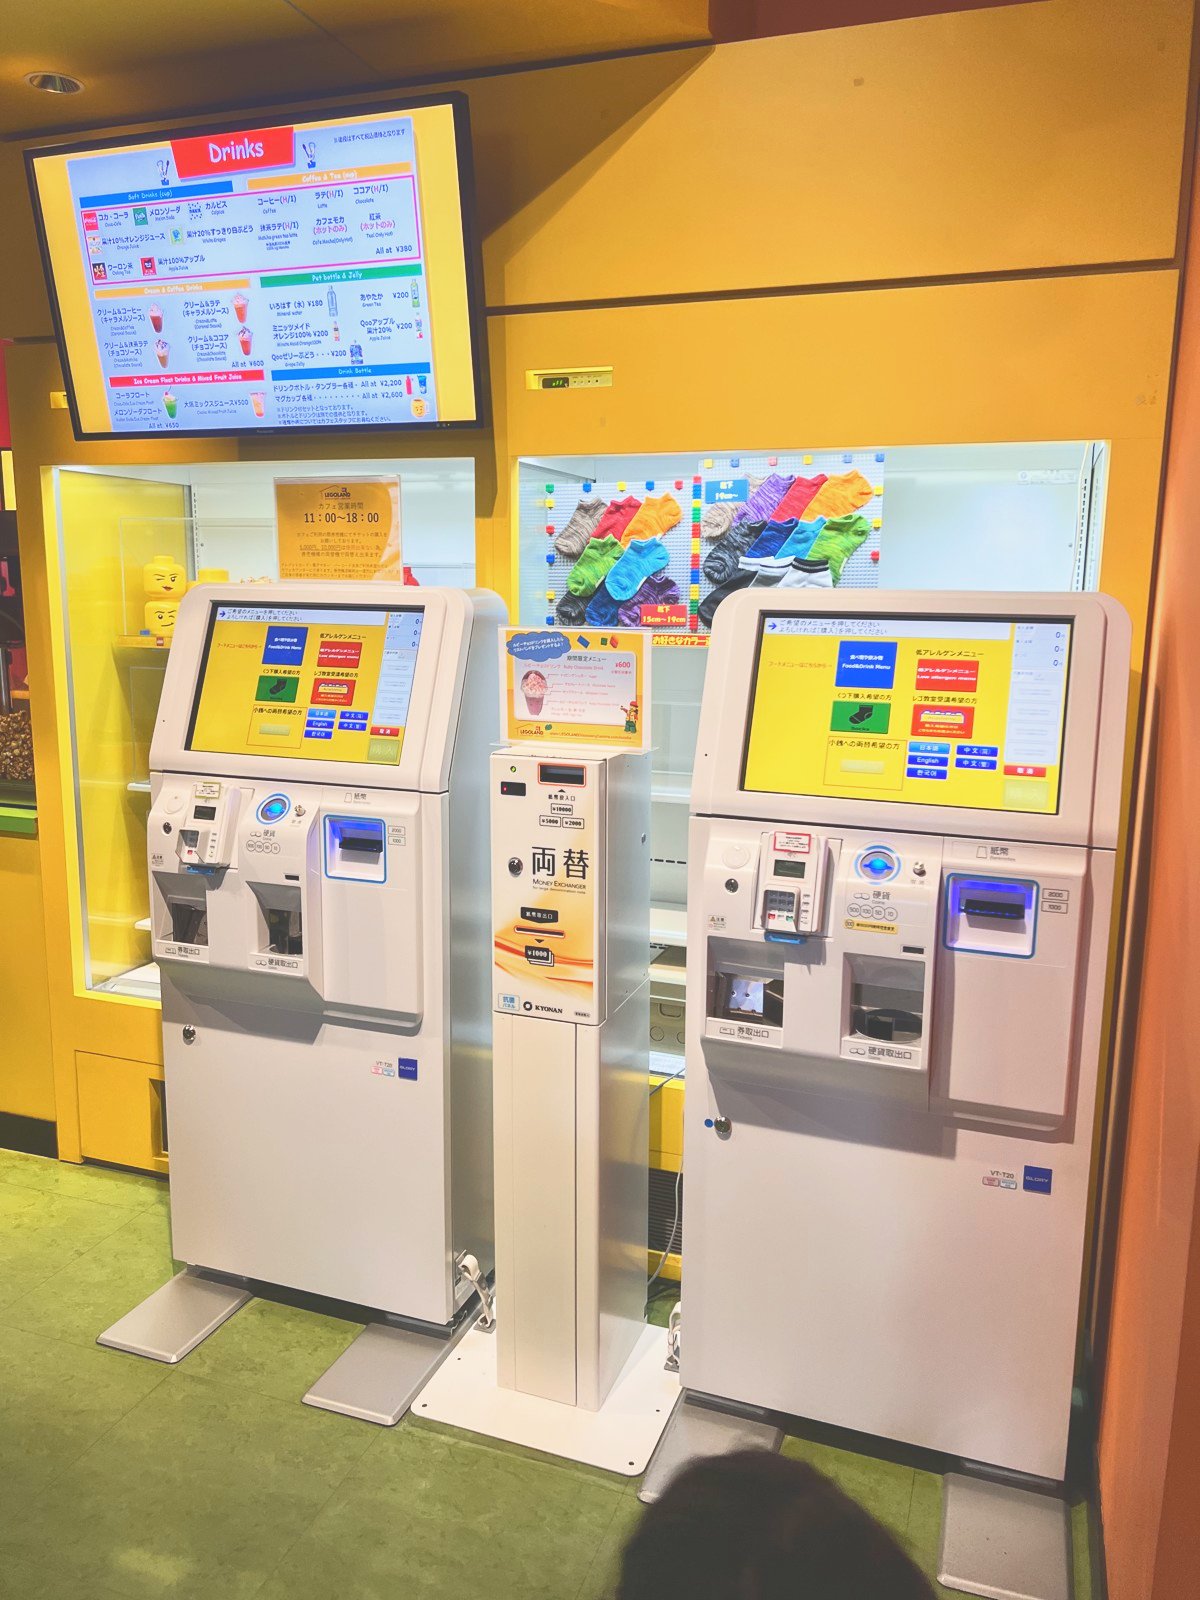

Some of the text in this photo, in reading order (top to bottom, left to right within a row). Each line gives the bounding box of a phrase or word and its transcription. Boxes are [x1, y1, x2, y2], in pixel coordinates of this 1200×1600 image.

[208, 138, 264, 163] Drinks
[141, 191, 158, 199] Drinks
[205, 200, 228, 210] カルピス
[98, 211, 129, 221] コカ・コーラ
[149, 205, 181, 217] メロンソーダ
[315, 216, 345, 226] カフェモカ
[369, 212, 381, 221] 紅茶
[313, 224, 348, 235] (ホットのみ)
[360, 220, 396, 231] (ホットのみ)
[375, 247, 384, 255] All
[395, 244, 413, 253] ¥380
[323, 272, 340, 280] bottle
[348, 271, 363, 280] Jelly
[360, 291, 409, 301] あやたか ¥200
[184, 300, 221, 309] クリーム&ラテ
[269, 301, 294, 310] いろはす
[97, 307, 142, 316] クリーム&コーヒー
[182, 307, 229, 317] (キャラメルソース)
[272, 322, 311, 332] ミニッツメイド
[360, 317, 396, 327] Qooアップル
[366, 322, 413, 335] 果汁20% ¥200
[187, 334, 229, 343] クリーム&ココア
[273, 331, 312, 339] オレンジ100%
[191, 342, 227, 351] (チョコソース)
[107, 348, 142, 357] (チョコソース)
[379, 379, 402, 387] ¥2,200
[381, 391, 403, 399] ¥2,600
[114, 408, 163, 416] メロンソーダフロート
[837, 692, 893, 701] くつ下購入希望の方
[919, 744, 939, 752] 日本語
[917, 756, 939, 764] English
[990, 846, 1009, 856] 紙幣
[531, 846, 589, 880] 両替
[872, 890, 891, 900] 硬貨
[1048, 903, 1062, 911] 1000
[527, 949, 548, 957] ¥1000
[535, 1004, 563, 1014] KYONAN
[737, 1026, 770, 1038] 券取出口
[868, 1046, 912, 1060] 硬貨取出口
[990, 1169, 1015, 1180] VT-T20
